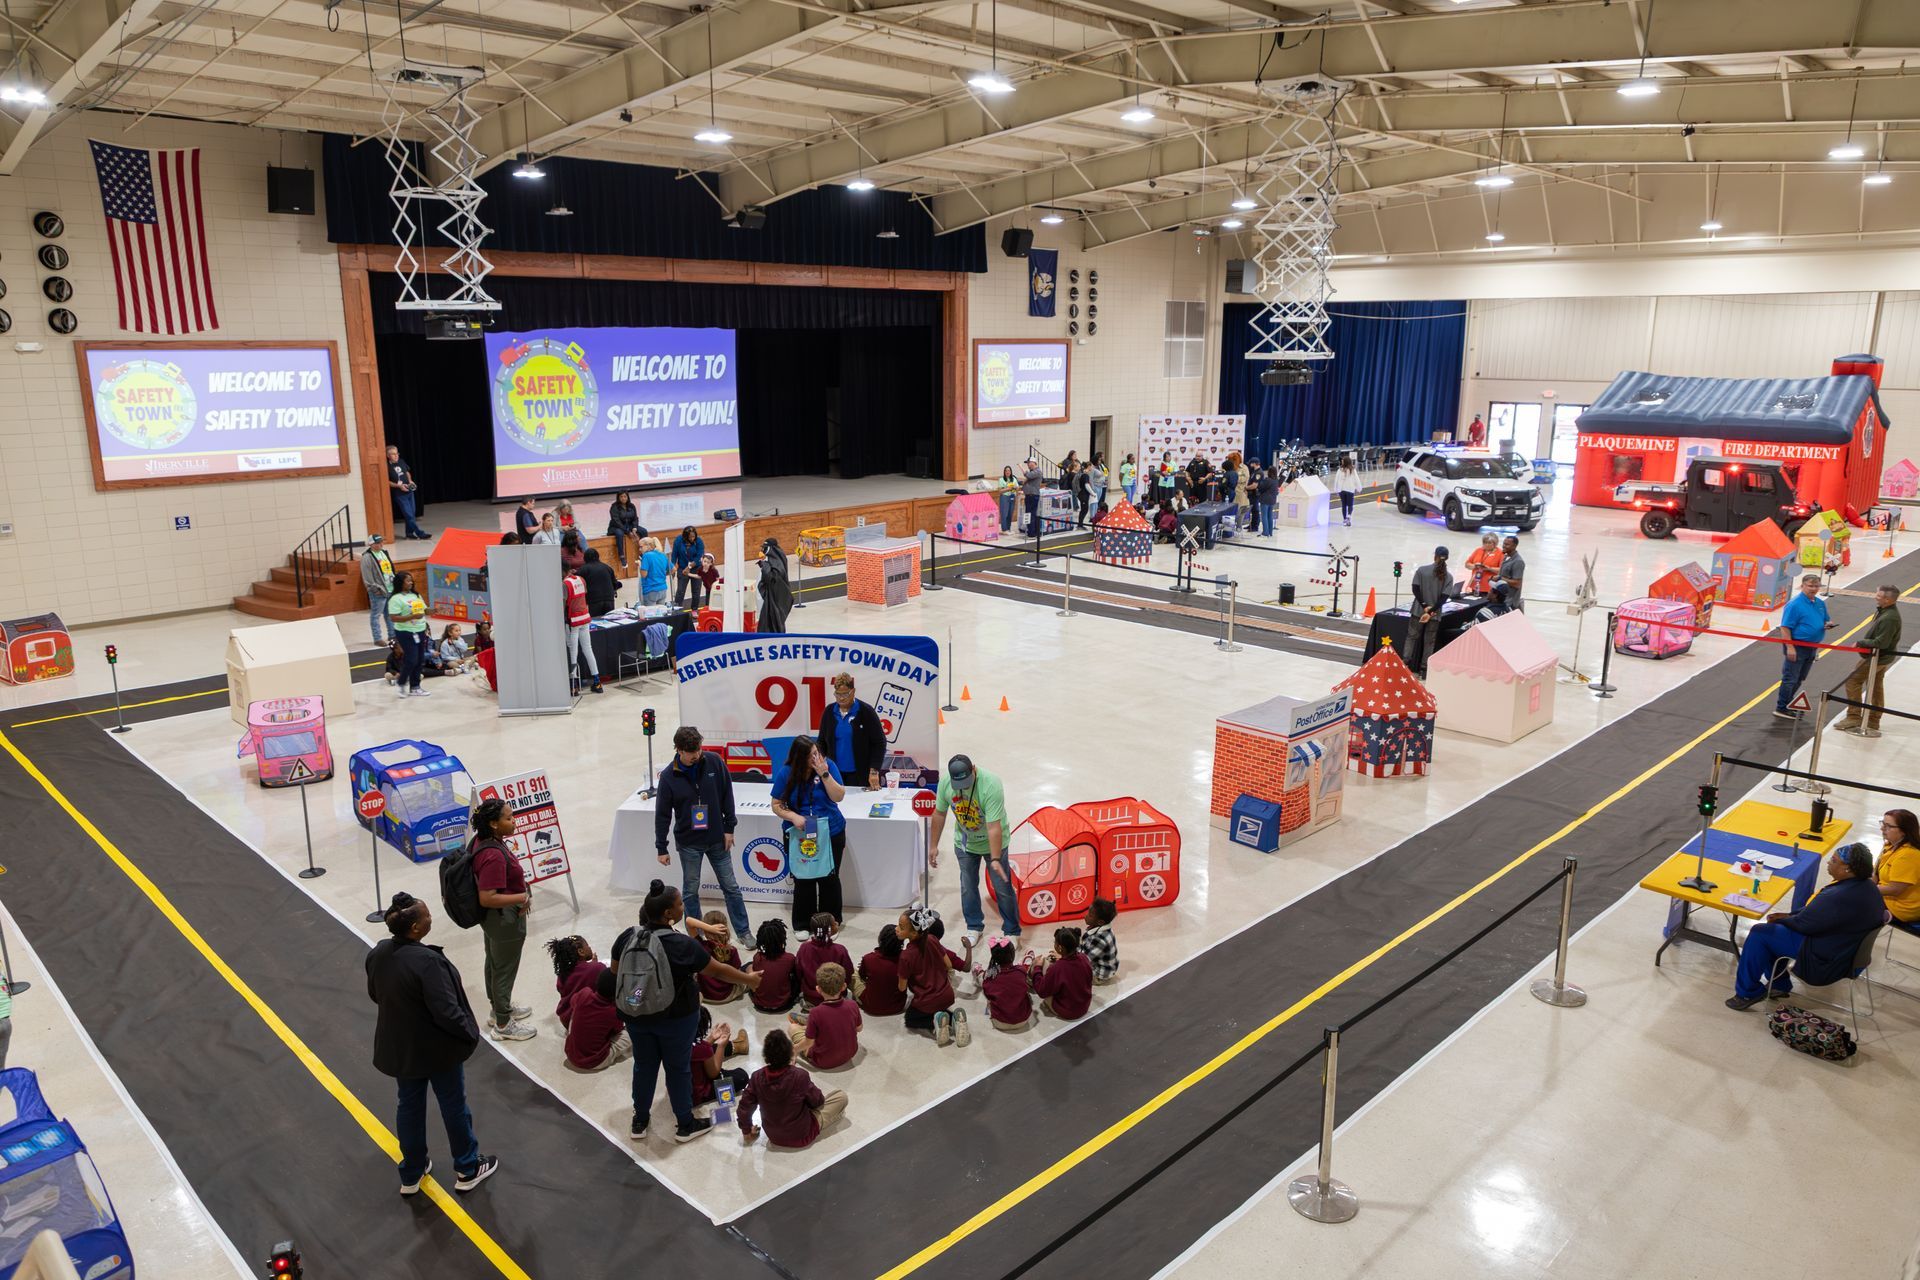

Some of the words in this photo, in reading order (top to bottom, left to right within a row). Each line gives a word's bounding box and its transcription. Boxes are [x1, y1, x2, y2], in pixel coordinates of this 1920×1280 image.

[612, 355, 699, 382] WELCOME
[704, 354, 727, 380] TO
[1019, 358, 1052, 370] WELCOME
[1053, 357, 1063, 370] TO
[208, 371, 294, 393] WELCOME
[299, 370, 322, 391] TO
[515, 375, 577, 396] SAFETY
[1015, 381, 1040, 394] SAFETY
[1042, 380, 1065, 392] TOWN!
[116, 388, 174, 404] SAFETY
[124, 405, 173, 422] TOWN
[523, 398, 574, 419] TOWN
[606, 404, 674, 431] SAFETY
[678, 400, 736, 427] TOWN!
[205, 408, 272, 432] SAFETY
[275, 406, 333, 428] TOWN!
[1580, 436, 1675, 452] PLAQUEMINE
[1725, 443, 1753, 456] FIRE
[1755, 444, 1840, 460] DEPARTMENT
[551, 467, 608, 481] IBERVILLE
[678, 464, 698, 473] LEPC
[676, 646, 764, 684] IBERVILLE
[768, 644, 835, 660] SAFETY
[839, 647, 895, 673] TOWN
[897, 661, 938, 687] DAY
[755, 676, 855, 730] 91
[883, 692, 905, 705] CALL
[877, 705, 903, 720] 9-1-1
[1296, 714, 1313, 728] Post
[1312, 708, 1334, 722] Office
[503, 784, 515, 799] IS
[517, 781, 527, 796] IT
[529, 776, 548, 793] 911
[361, 797, 384, 810] STOP
[518, 796, 532, 807] NOT
[535, 791, 551, 803] 911?
[914, 799, 936, 808] STOP
[431, 815, 468, 830] POLICE
[514, 815, 528, 826] HEN
[529, 812, 539, 823] TO
[539, 809, 556, 820] DIAL:
[744, 838, 770, 854] IBERVILLE
[748, 871, 786, 884] GOVERNMENT
